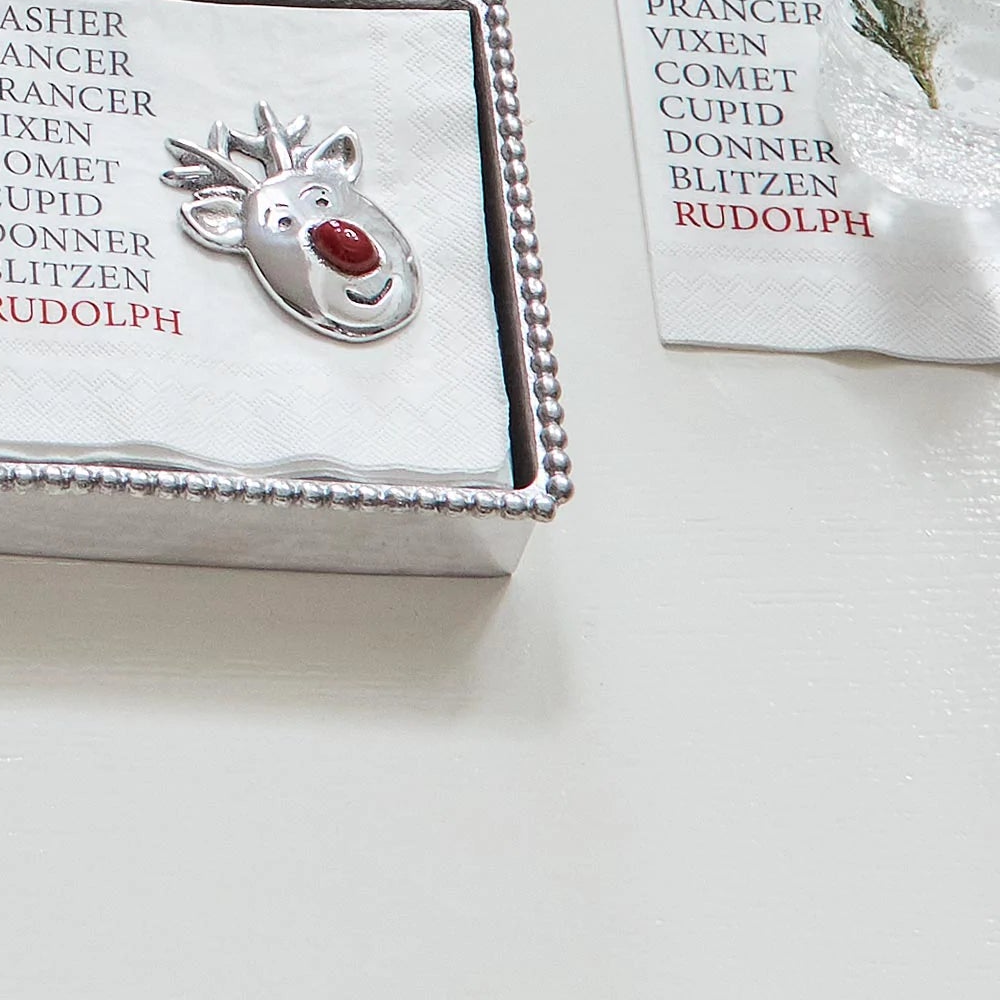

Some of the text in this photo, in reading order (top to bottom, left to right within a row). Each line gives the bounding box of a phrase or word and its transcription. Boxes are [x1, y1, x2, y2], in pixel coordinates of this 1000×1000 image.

[645, 25, 769, 58] VIXEN
[654, 59, 798, 93] COMET
[658, 94, 785, 128] CUPID
[663, 128, 841, 166] DONNER
[668, 164, 839, 199] BLITZEN
[672, 200, 875, 239] RUDOLPH
